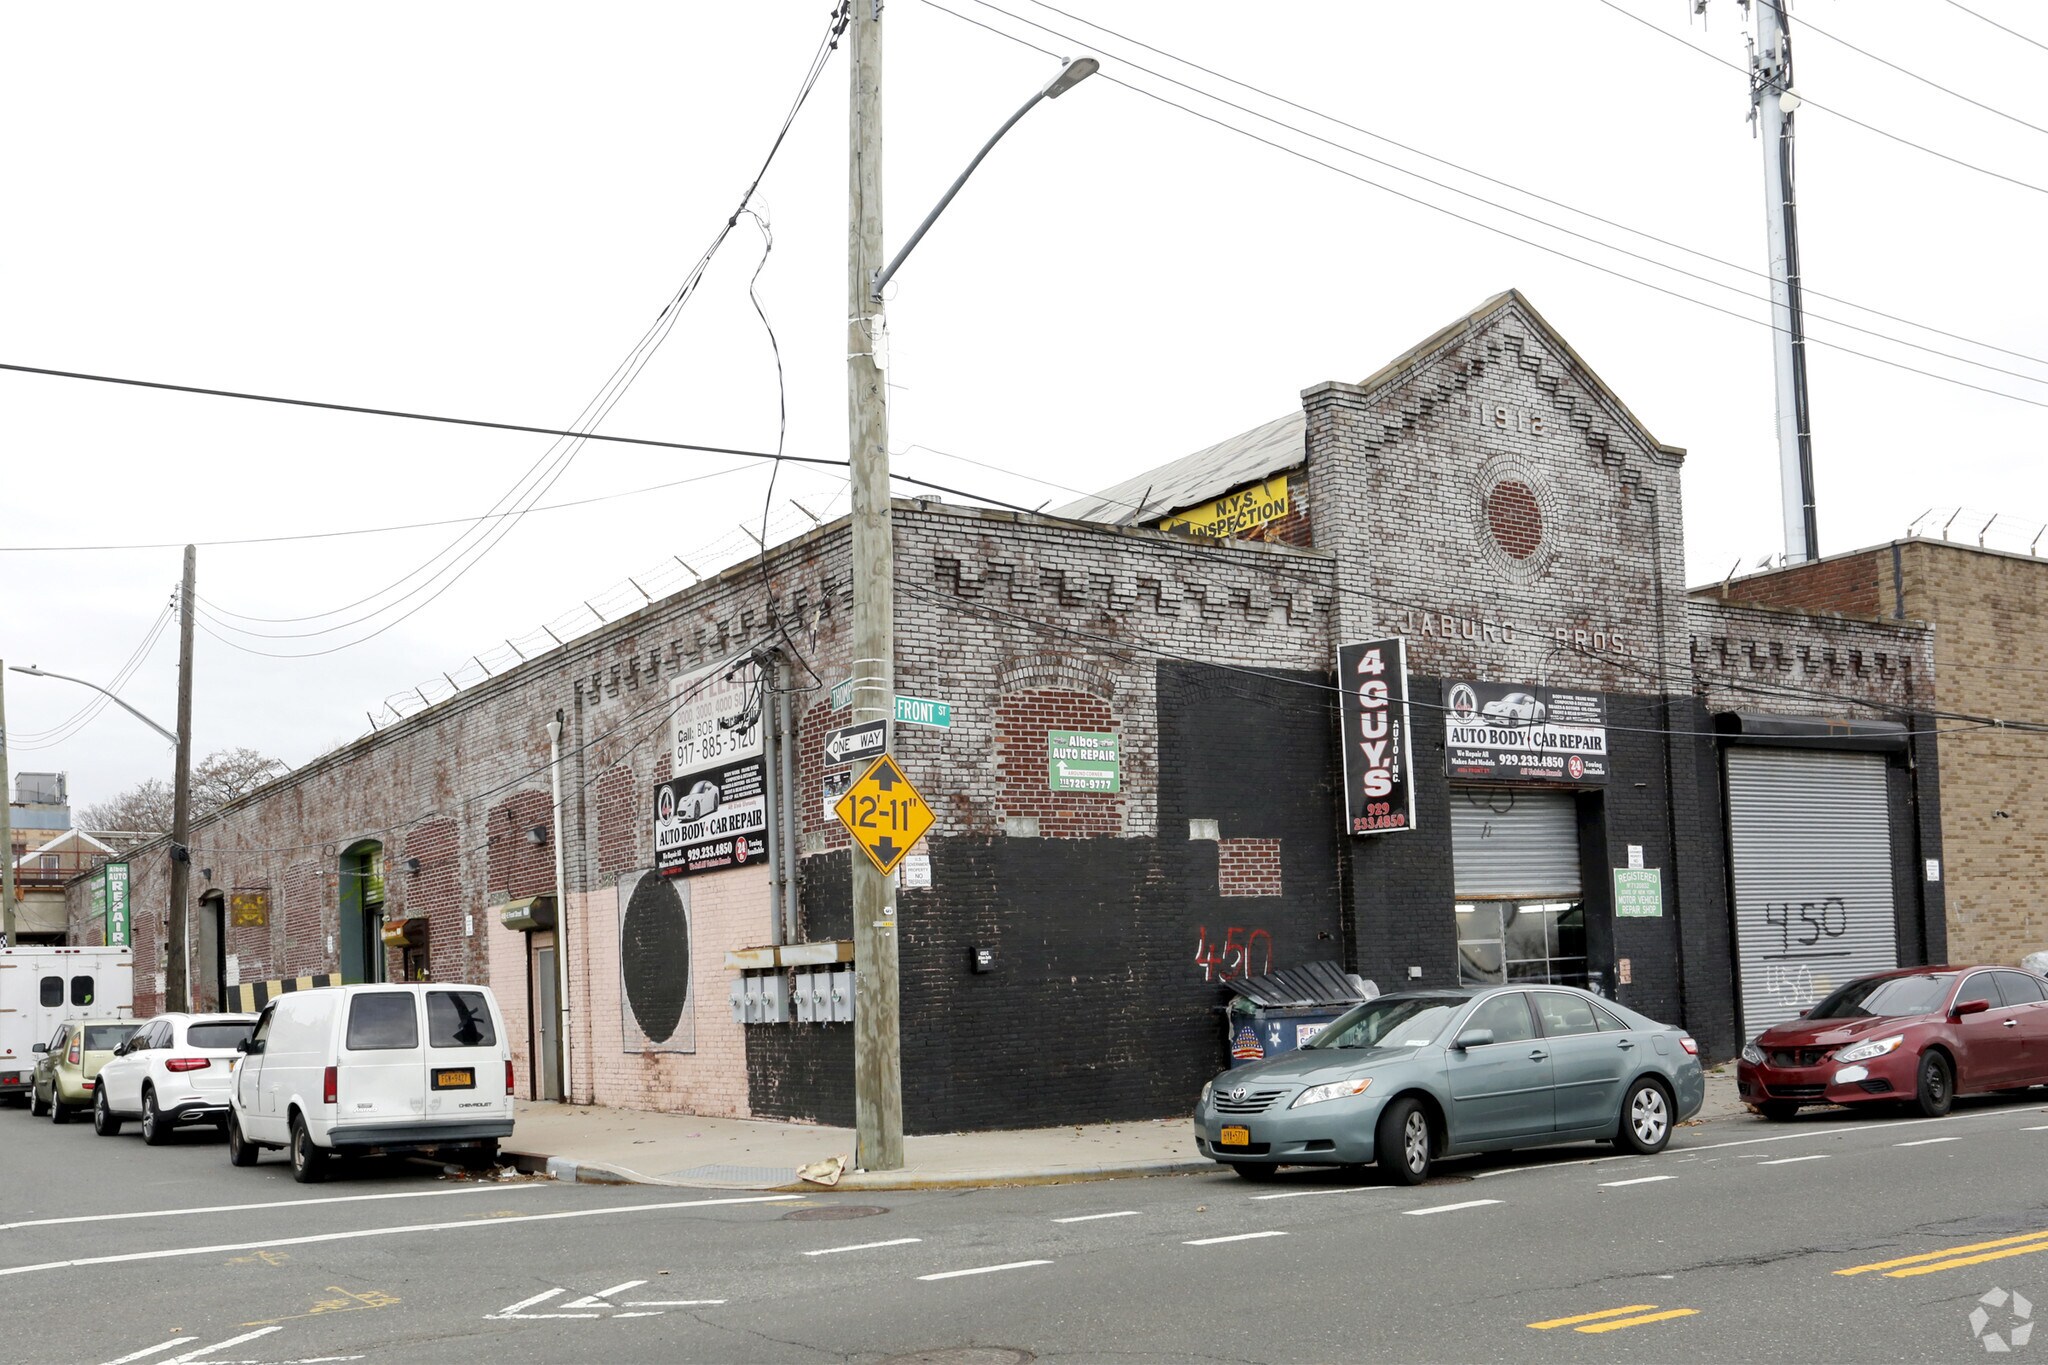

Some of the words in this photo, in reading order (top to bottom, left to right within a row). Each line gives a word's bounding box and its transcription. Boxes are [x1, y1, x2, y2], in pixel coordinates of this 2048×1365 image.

[1481, 404, 1545, 436] 1912
[1216, 492, 1257, 518] N.Y.S.
[1358, 649, 1384, 675] 4
[897, 700, 934, 722] FRONT
[938, 706, 946, 716] ST
[678, 727, 694, 743] Call:
[697, 720, 713, 736] BOB
[1452, 728, 1486, 744] AUTO
[1490, 730, 1526, 745] BODY
[1534, 732, 1557, 747] CAR
[1560, 734, 1602, 750] REPAIR
[833, 738, 850, 754] ONE
[860, 731, 881, 747] WAY
[1069, 736, 1098, 747] Albos
[1053, 748, 1078, 759] AUTO
[1081, 750, 1115, 761] REPAIR
[1466, 750, 1481, 758] Repair
[1499, 754, 1563, 768] 929.233.4850
[1571, 760, 1581, 770] 24
[1585, 761, 1602, 769] Towing
[1070, 780, 1110, 789] 720-9777
[1367, 802, 1390, 816] 929
[660, 828, 679, 846] AUTO
[682, 821, 705, 841] BODY
[710, 816, 727, 834] CAR
[729, 809, 762, 831] REPAIR
[688, 842, 732, 861] 929.233.4850
[738, 841, 745, 853] 24
[1618, 872, 1657, 883] REGISTERED
[1618, 896, 1636, 904] MOTOR
[1638, 896, 1659, 904] VEHICLE
[112, 881, 124, 942] REPAIR
[1622, 905, 1640, 914] REPAIR
[1642, 905, 1656, 914] SHOP
[1766, 898, 1846, 953] 450
[1195, 927, 1272, 982] 450
